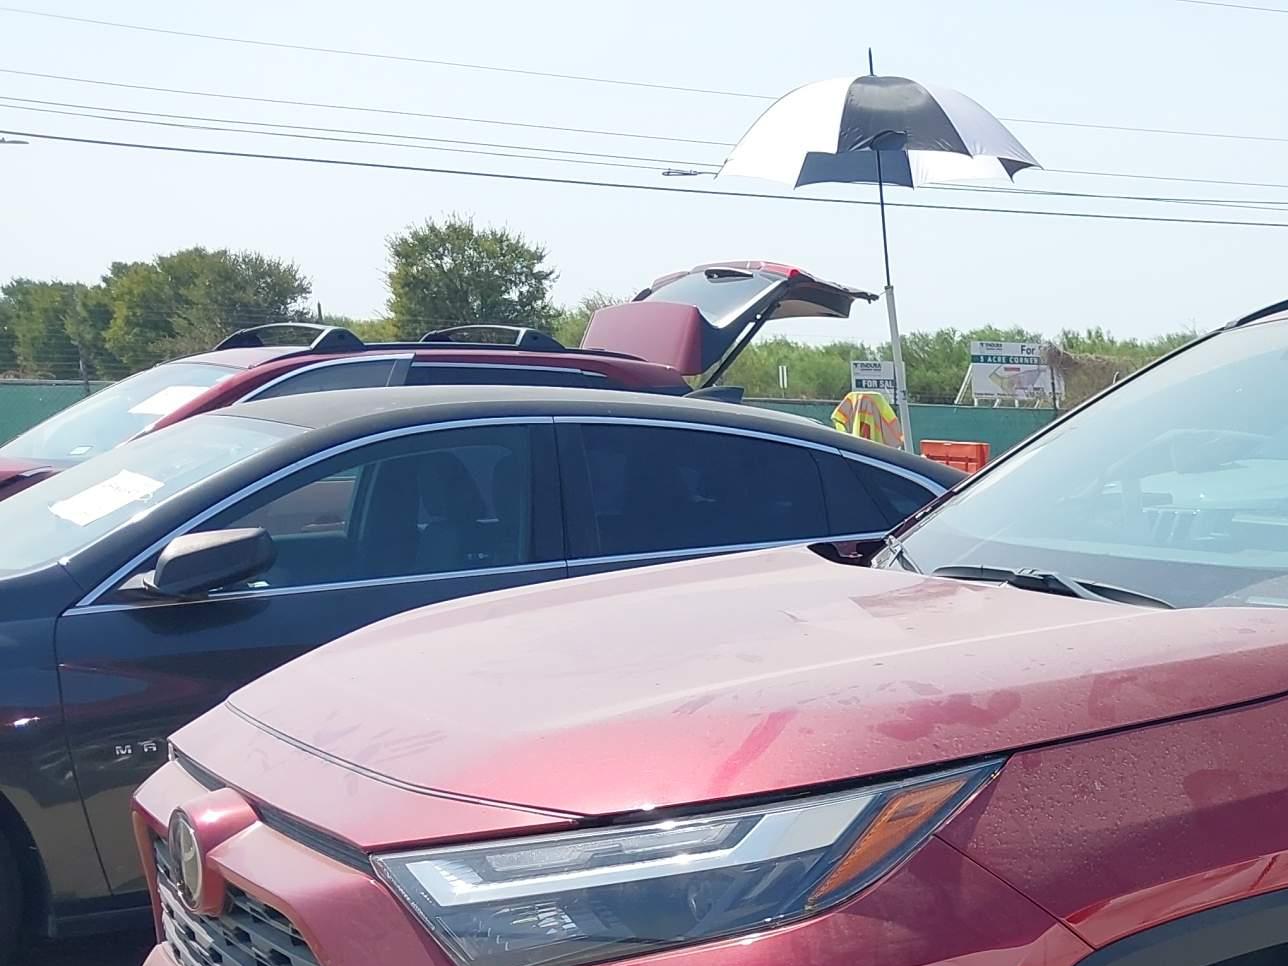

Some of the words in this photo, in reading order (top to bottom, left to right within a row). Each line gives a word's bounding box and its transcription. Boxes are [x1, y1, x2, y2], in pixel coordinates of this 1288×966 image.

[1020, 344, 1036, 355] For
[862, 379, 878, 388] FOR
[879, 379, 894, 388] SAL
